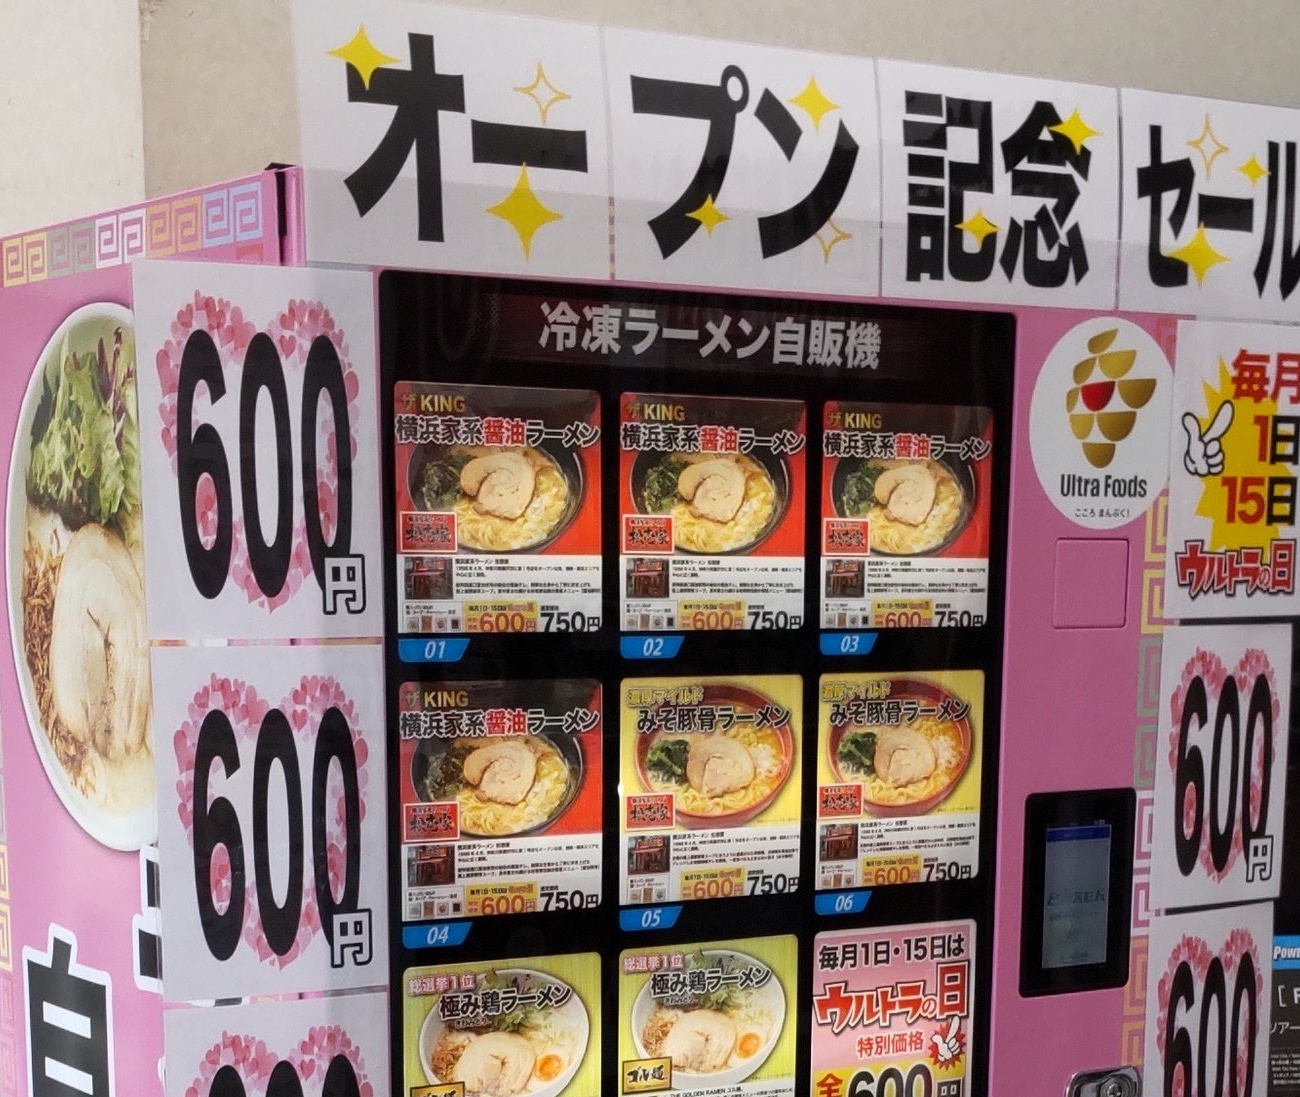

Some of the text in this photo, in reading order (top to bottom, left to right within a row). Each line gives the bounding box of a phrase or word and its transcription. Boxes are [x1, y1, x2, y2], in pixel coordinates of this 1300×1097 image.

[539, 301, 882, 369] 冷凍ラーメン自販機
[420, 394, 465, 413] KING
[644, 404, 685, 421] KING
[396, 414, 600, 448] 横浜家系醤油ラーメン
[844, 413, 882, 428] KING
[621, 424, 805, 454] 横浜家系醤油ラーメン
[823, 432, 991, 460] 横浜家系醤油ラーメン
[176, 328, 367, 615] 600円
[1060, 474, 1147, 498] Ultra Foods
[1221, 476, 1298, 526] 15日
[1175, 539, 1297, 600] ウルトラの日
[541, 612, 600, 632] 750円
[748, 611, 801, 630] 750円
[935, 610, 985, 628] 750円
[424, 641, 446, 659] 01
[643, 639, 664, 657] 02
[840, 636, 859, 652] 03
[424, 691, 469, 708] KING
[400, 708, 600, 740] 横浜家系醤油ラーメン
[637, 706, 791, 734] みそ豚骨ラーメン
[830, 701, 970, 726] みそ豚骨ラーメン
[1175, 673, 1274, 883] 600円
[193, 706, 373, 968] 600円
[925, 862, 971, 881] 750円
[748, 874, 799, 895] 750円
[540, 891, 599, 911] 750円
[835, 895, 853, 911] 06
[641, 910, 662, 927] 05
[427, 926, 449, 944] 04
[818, 934, 965, 971] 毎月1日・15日は
[651, 967, 771, 998] 極み鶏ラーメン
[439, 983, 573, 1020] 極み鶏ラーメン
[813, 959, 971, 1035] ウルトラの日
[857, 1031, 925, 1059] 特別価格
